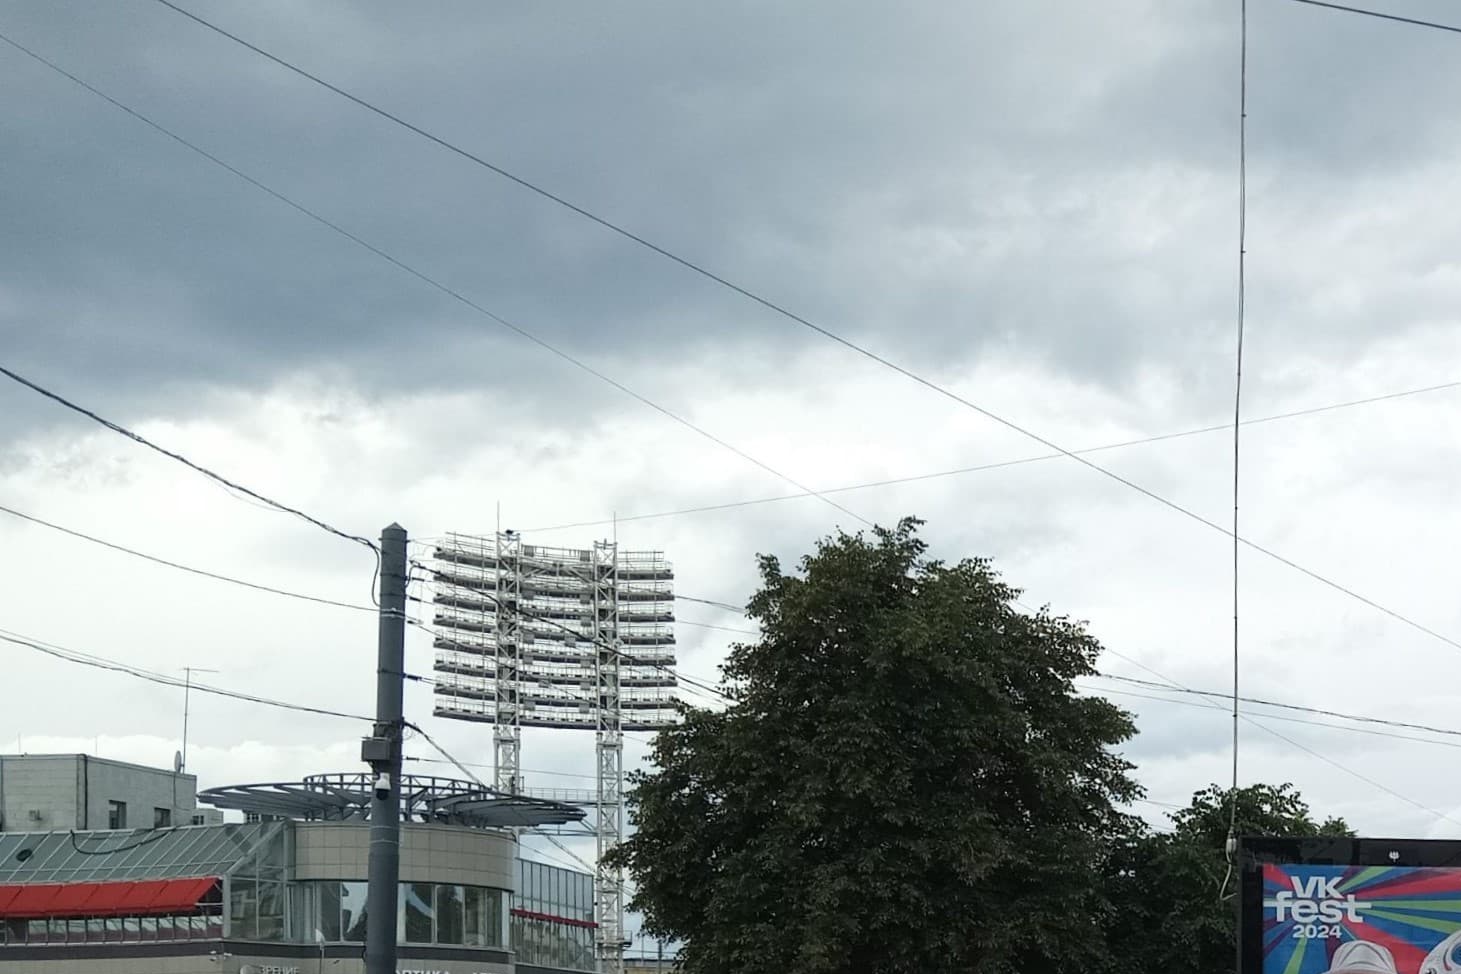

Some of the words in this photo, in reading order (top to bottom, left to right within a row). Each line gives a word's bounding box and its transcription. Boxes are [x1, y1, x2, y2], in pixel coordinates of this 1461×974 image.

[1291, 876, 1343, 898] VK
[1263, 890, 1372, 923] fest
[1292, 925, 1341, 938] 2024
